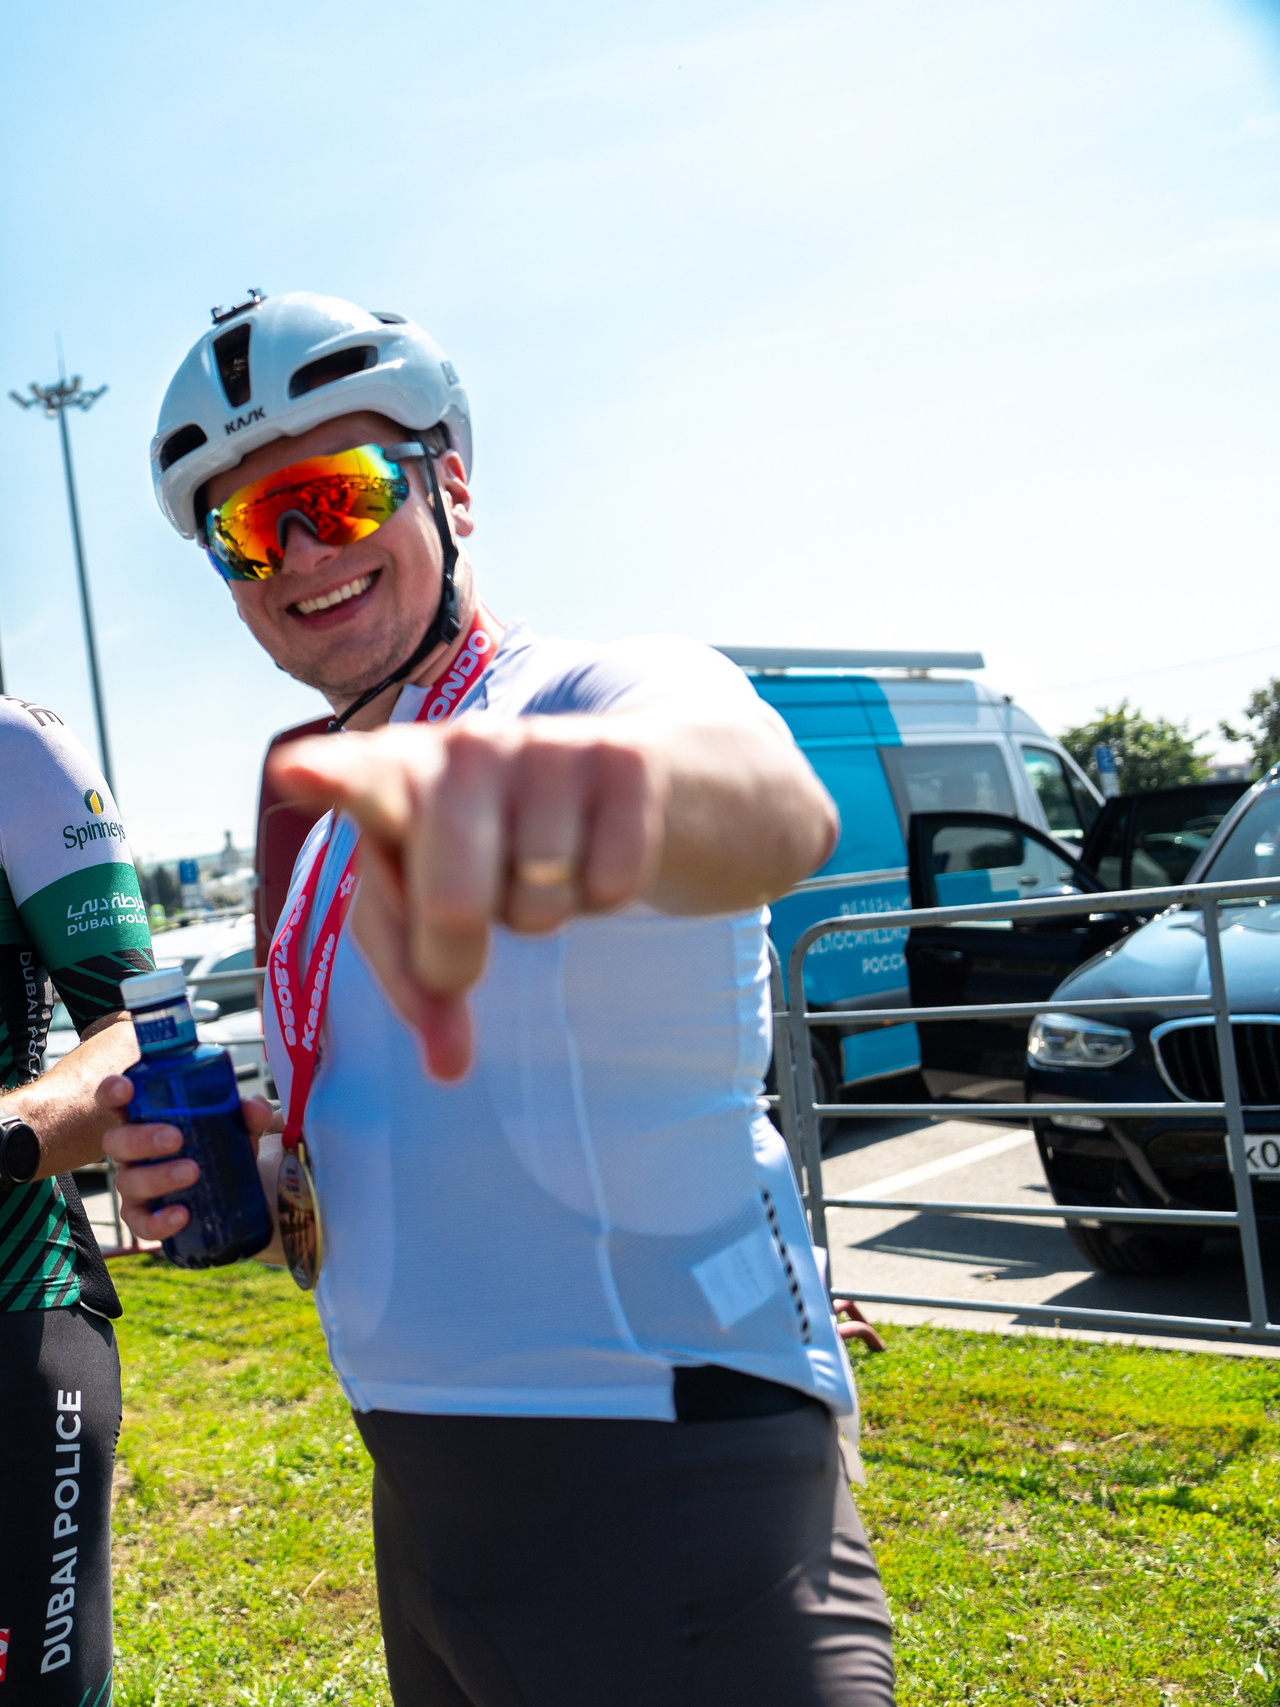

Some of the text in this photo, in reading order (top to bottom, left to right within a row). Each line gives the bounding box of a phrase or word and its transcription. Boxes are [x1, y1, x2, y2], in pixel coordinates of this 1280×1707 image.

[427, 629, 492, 723] ONDO
[62, 820, 126, 850] Spinneys
[67, 916, 114, 936] DUBAI
[19, 951, 39, 1020] DUBAI
[40, 1389, 83, 1675] DUBAI POLICE
